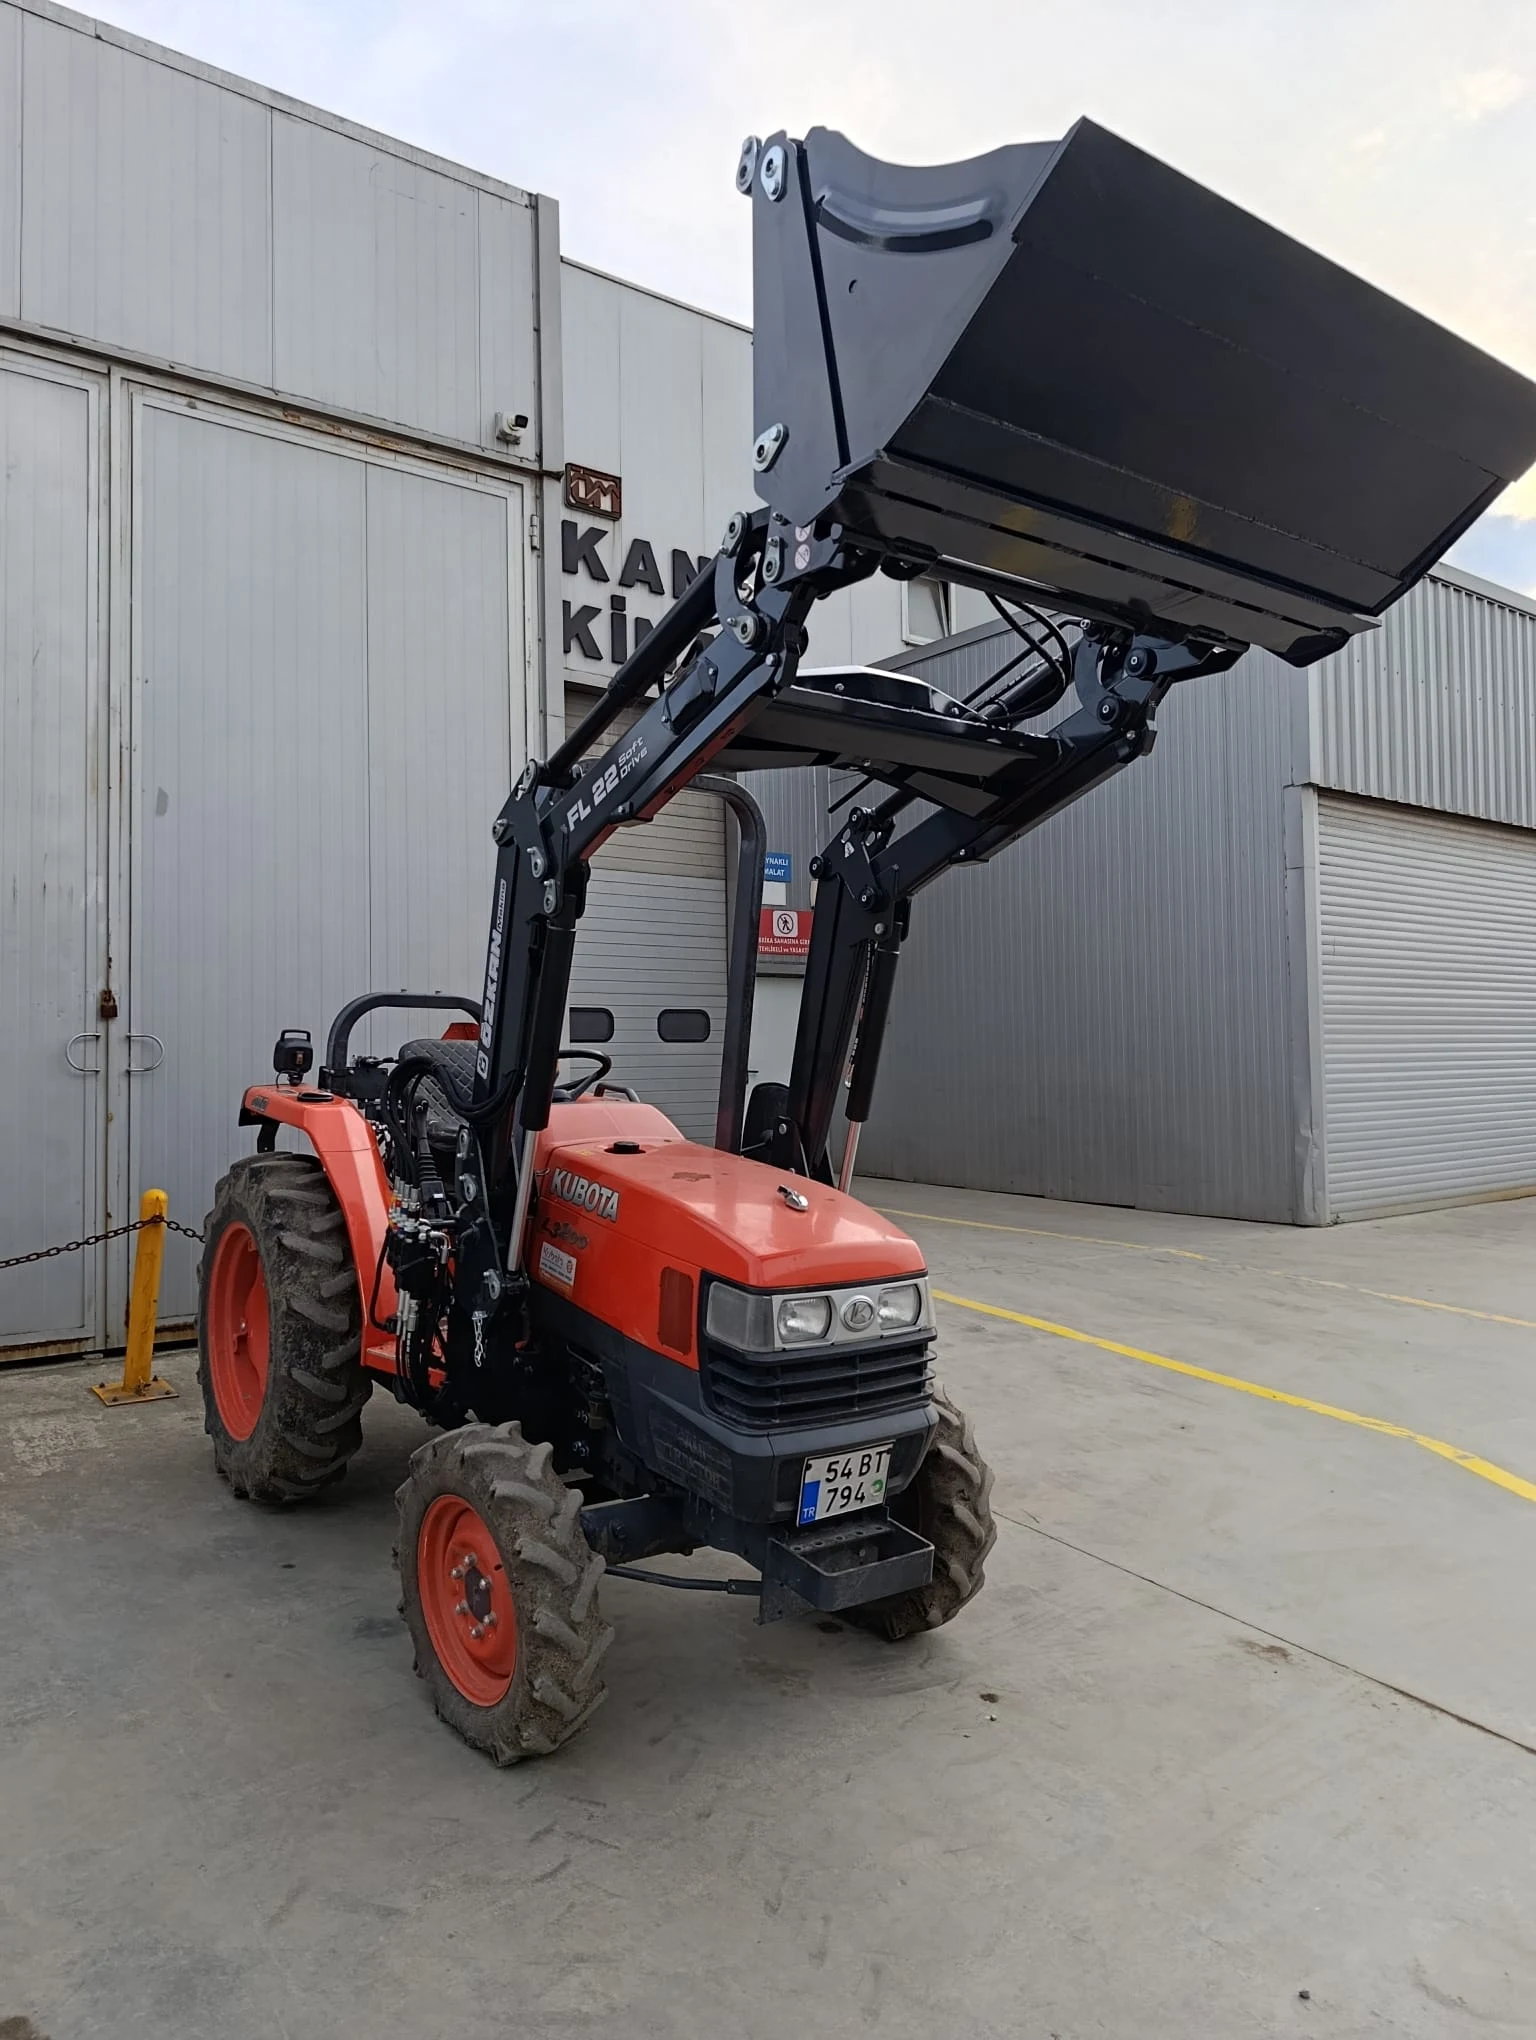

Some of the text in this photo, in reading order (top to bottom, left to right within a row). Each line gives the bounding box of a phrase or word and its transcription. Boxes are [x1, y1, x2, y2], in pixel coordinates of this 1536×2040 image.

[618, 736, 643, 767] Soft
[620, 747, 648, 780] Drive
[566, 763, 620, 832] FL 22
[550, 1168, 620, 1223] KUBOTA
[825, 1452, 889, 1483] 54 BT
[803, 1507, 815, 1518] TR
[825, 1482, 865, 1513] 794
